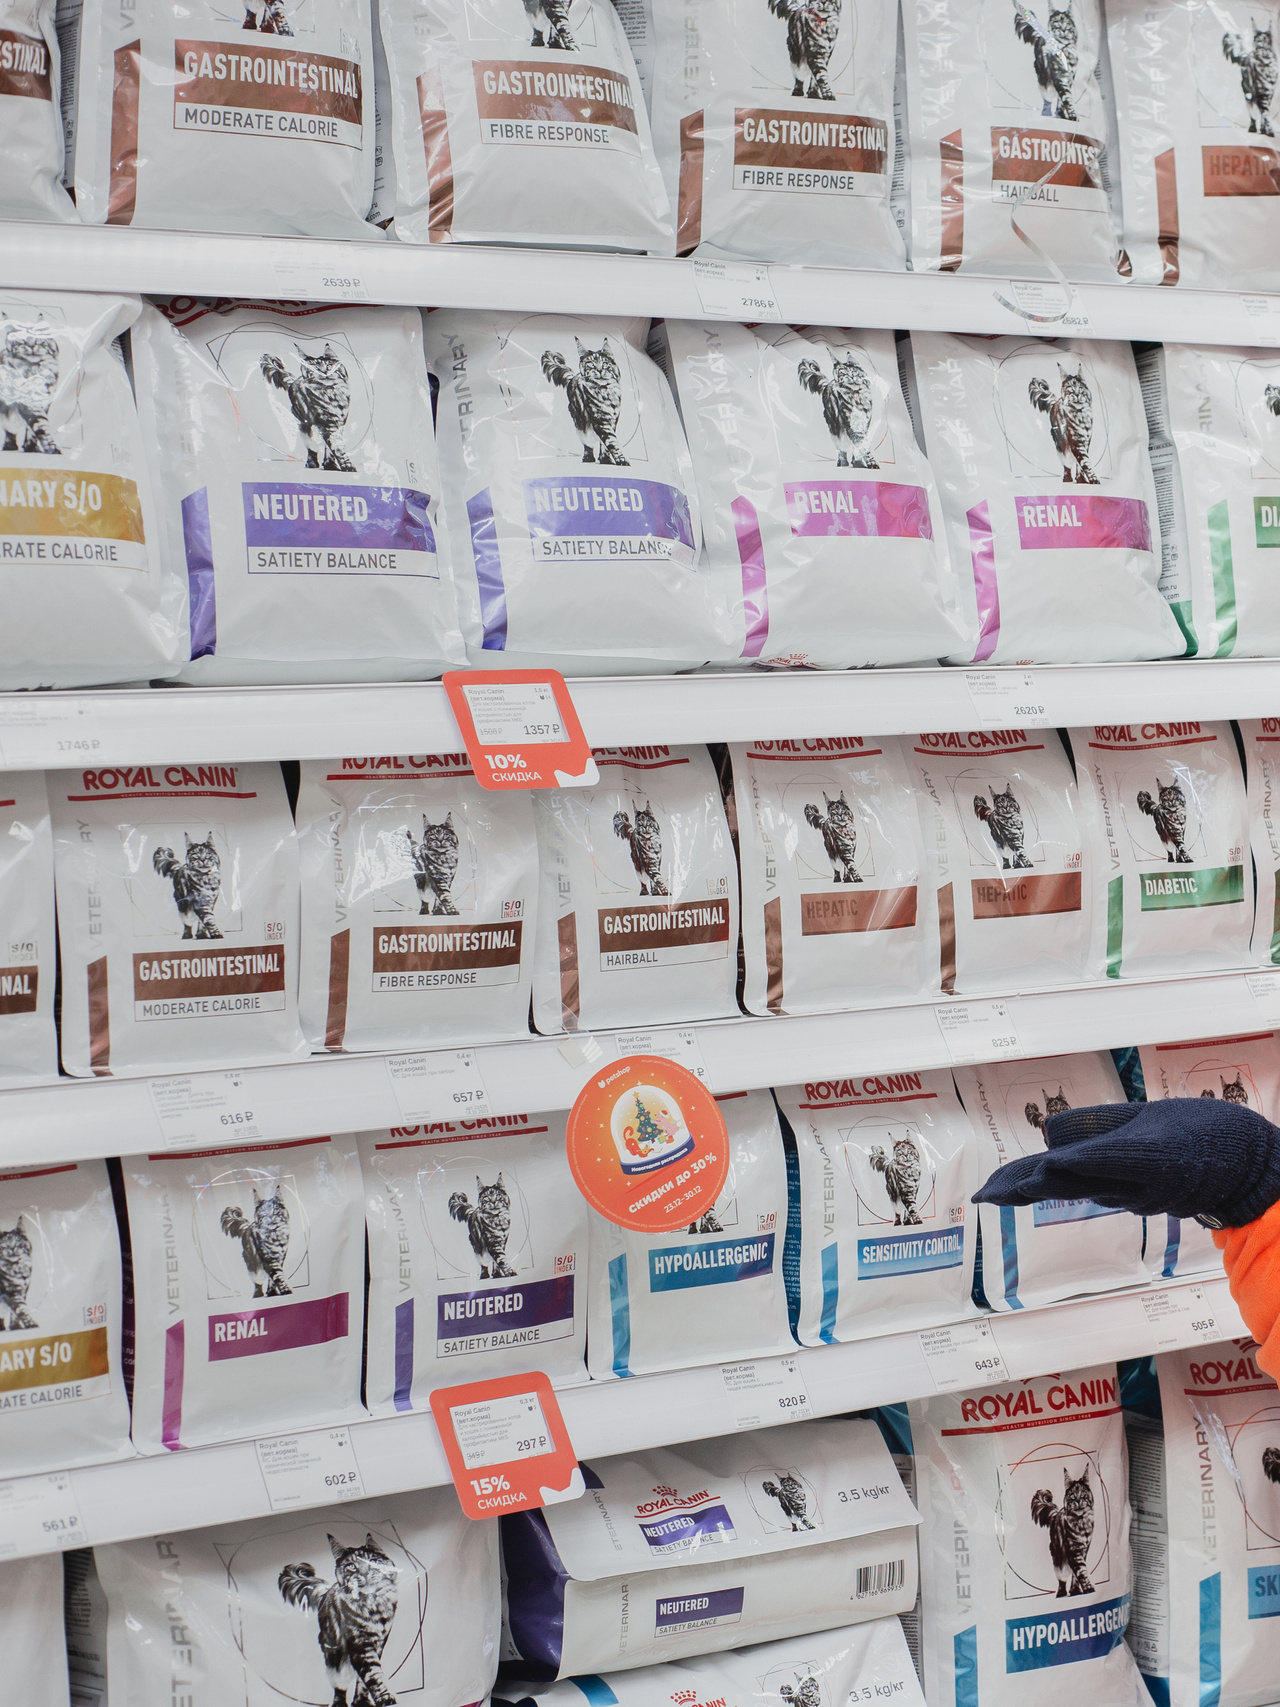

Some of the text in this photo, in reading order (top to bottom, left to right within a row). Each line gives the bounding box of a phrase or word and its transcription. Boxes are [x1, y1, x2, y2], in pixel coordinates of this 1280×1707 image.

[0, 42, 47, 76] STINAL
[184, 51, 359, 99] GASTROINTESTINAL
[184, 108, 338, 138] MODERATE CALORIE
[490, 123, 610, 144] FIBRE RESPONSE
[743, 118, 887, 152] GASTROINTESTINAL
[742, 170, 855, 190] FIBRE RESPONSE
[253, 494, 369, 523] NEUTERED
[533, 486, 644, 513] NEUTERED
[794, 490, 859, 515] RENAL
[1023, 505, 1082, 528] RENAL
[51, 543, 118, 562] CALORIE
[543, 540, 604, 557] SATIETY
[257, 551, 398, 570] SATIETY BALANCE
[920, 729, 1027, 749] ROYAL CANIN
[1095, 721, 1201, 743] ROYAL CANIN
[484, 753, 527, 769] 10%
[82, 766, 237, 791] ROYAL CANIN
[491, 771, 542, 782] СКИДКА
[1094, 764, 1121, 871] VETERINARY
[977, 883, 1028, 904] HEPATIC
[1145, 877, 1199, 896] DIABETIC
[504, 900, 522, 911] S/O
[806, 899, 859, 919] HEPATIC
[266, 921, 283, 932] S/O
[603, 905, 725, 935] GASTROINTESTINAL
[378, 929, 517, 954] GASTROINTESTINAL
[139, 953, 280, 982] GASTROINTESTINAL
[606, 952, 659, 967] HAIRBALL
[379, 972, 477, 988] FIBRE RESPONSE
[143, 998, 261, 1016] MODERATE CALORIE
[605, 1065, 631, 1085] petshop
[805, 1072, 922, 1101] ROYAL CANIN
[976, 1080, 1008, 1167] TERINARY
[810, 1123, 835, 1238] VETERINARY
[556, 1255, 574, 1265] S/O
[654, 1241, 768, 1275] HYPOALLERGENIC
[862, 1233, 962, 1265] SENSITIVITY CONTROL
[443, 1292, 524, 1320] NEUTERED
[214, 1318, 269, 1343] RENAL
[443, 1329, 541, 1354] SATIETY BALANCE
[1, 1342, 73, 1372] ARY S/O
[1189, 1357, 1263, 1386] ROYAL
[30, 1385, 83, 1405] CALORIE
[961, 1375, 1117, 1422] ROYAL CANIN
[1026, 1419, 1058, 1428] NUTRITION
[470, 1474, 511, 1496] 15%
[837, 1488, 860, 1504] 3.5
[477, 1491, 528, 1510] СКИДКА
[637, 1489, 710, 1515] ROYAL CANIN
[644, 1516, 696, 1538] NEUTERED
[654, 1542, 682, 1554] SATIETY
[659, 1597, 710, 1616] NEUTERED
[659, 1617, 718, 1635] SATIETY BALANCE
[849, 1687, 872, 1703] 3.5
